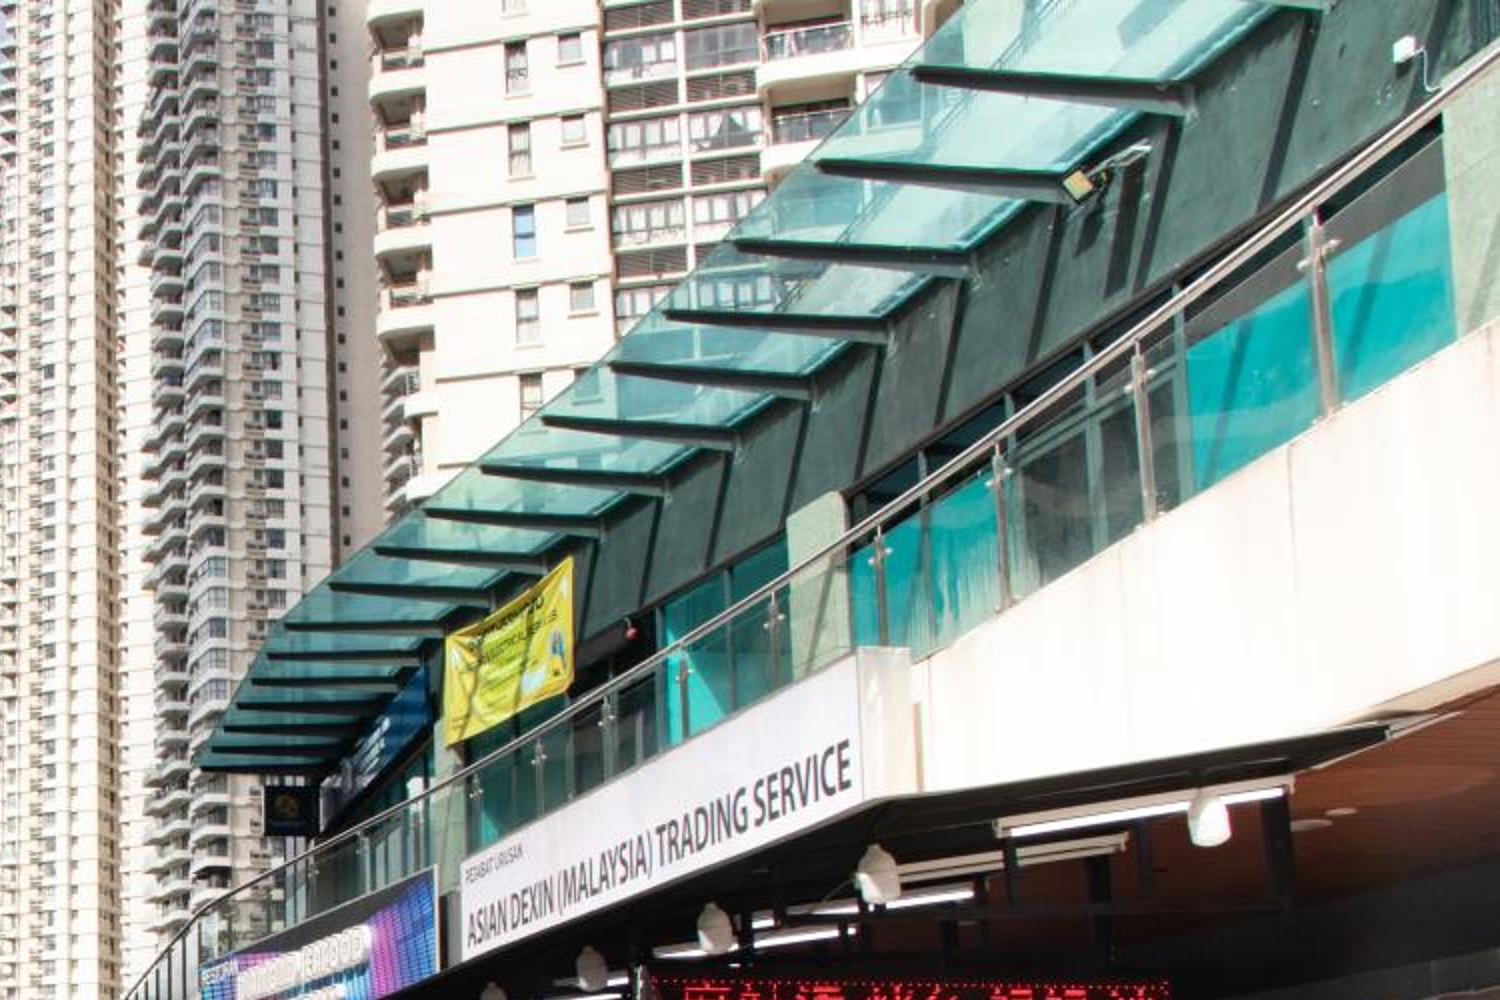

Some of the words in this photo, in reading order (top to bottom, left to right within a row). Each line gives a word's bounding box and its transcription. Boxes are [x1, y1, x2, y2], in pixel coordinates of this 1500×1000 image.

[467, 899, 507, 947] ASIAN
[510, 876, 553, 930] DEXIN
[557, 829, 653, 916] (MALAYSIA)
[655, 787, 749, 867] TRADING
[753, 739, 852, 827] SERVICE
